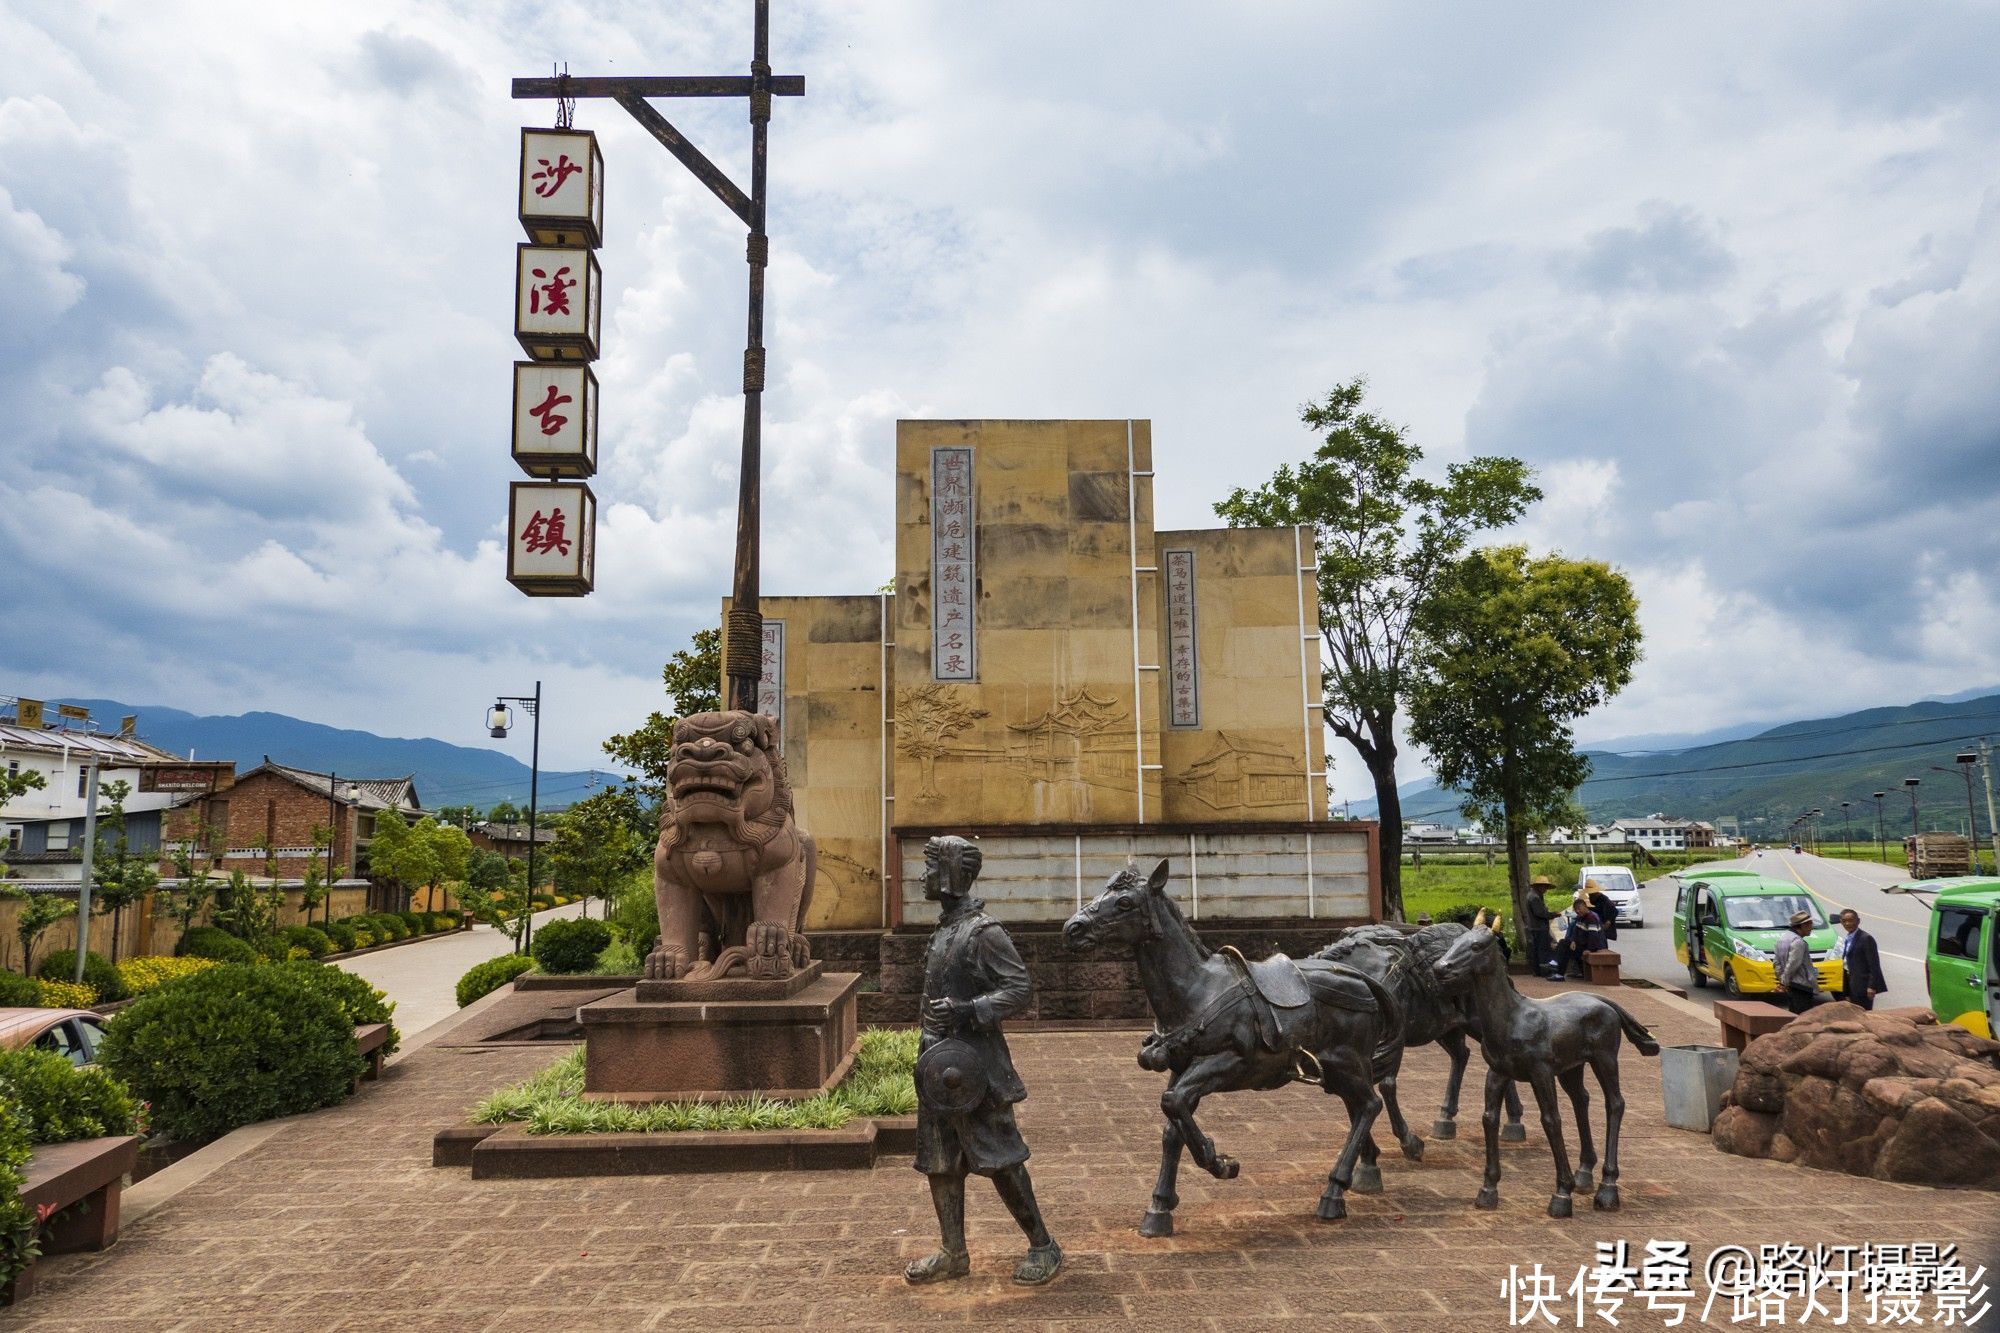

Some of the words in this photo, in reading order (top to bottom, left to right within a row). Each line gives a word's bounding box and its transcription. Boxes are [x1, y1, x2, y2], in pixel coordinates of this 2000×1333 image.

[941, 454, 966, 673] 世界濒危建筑遗产名录
